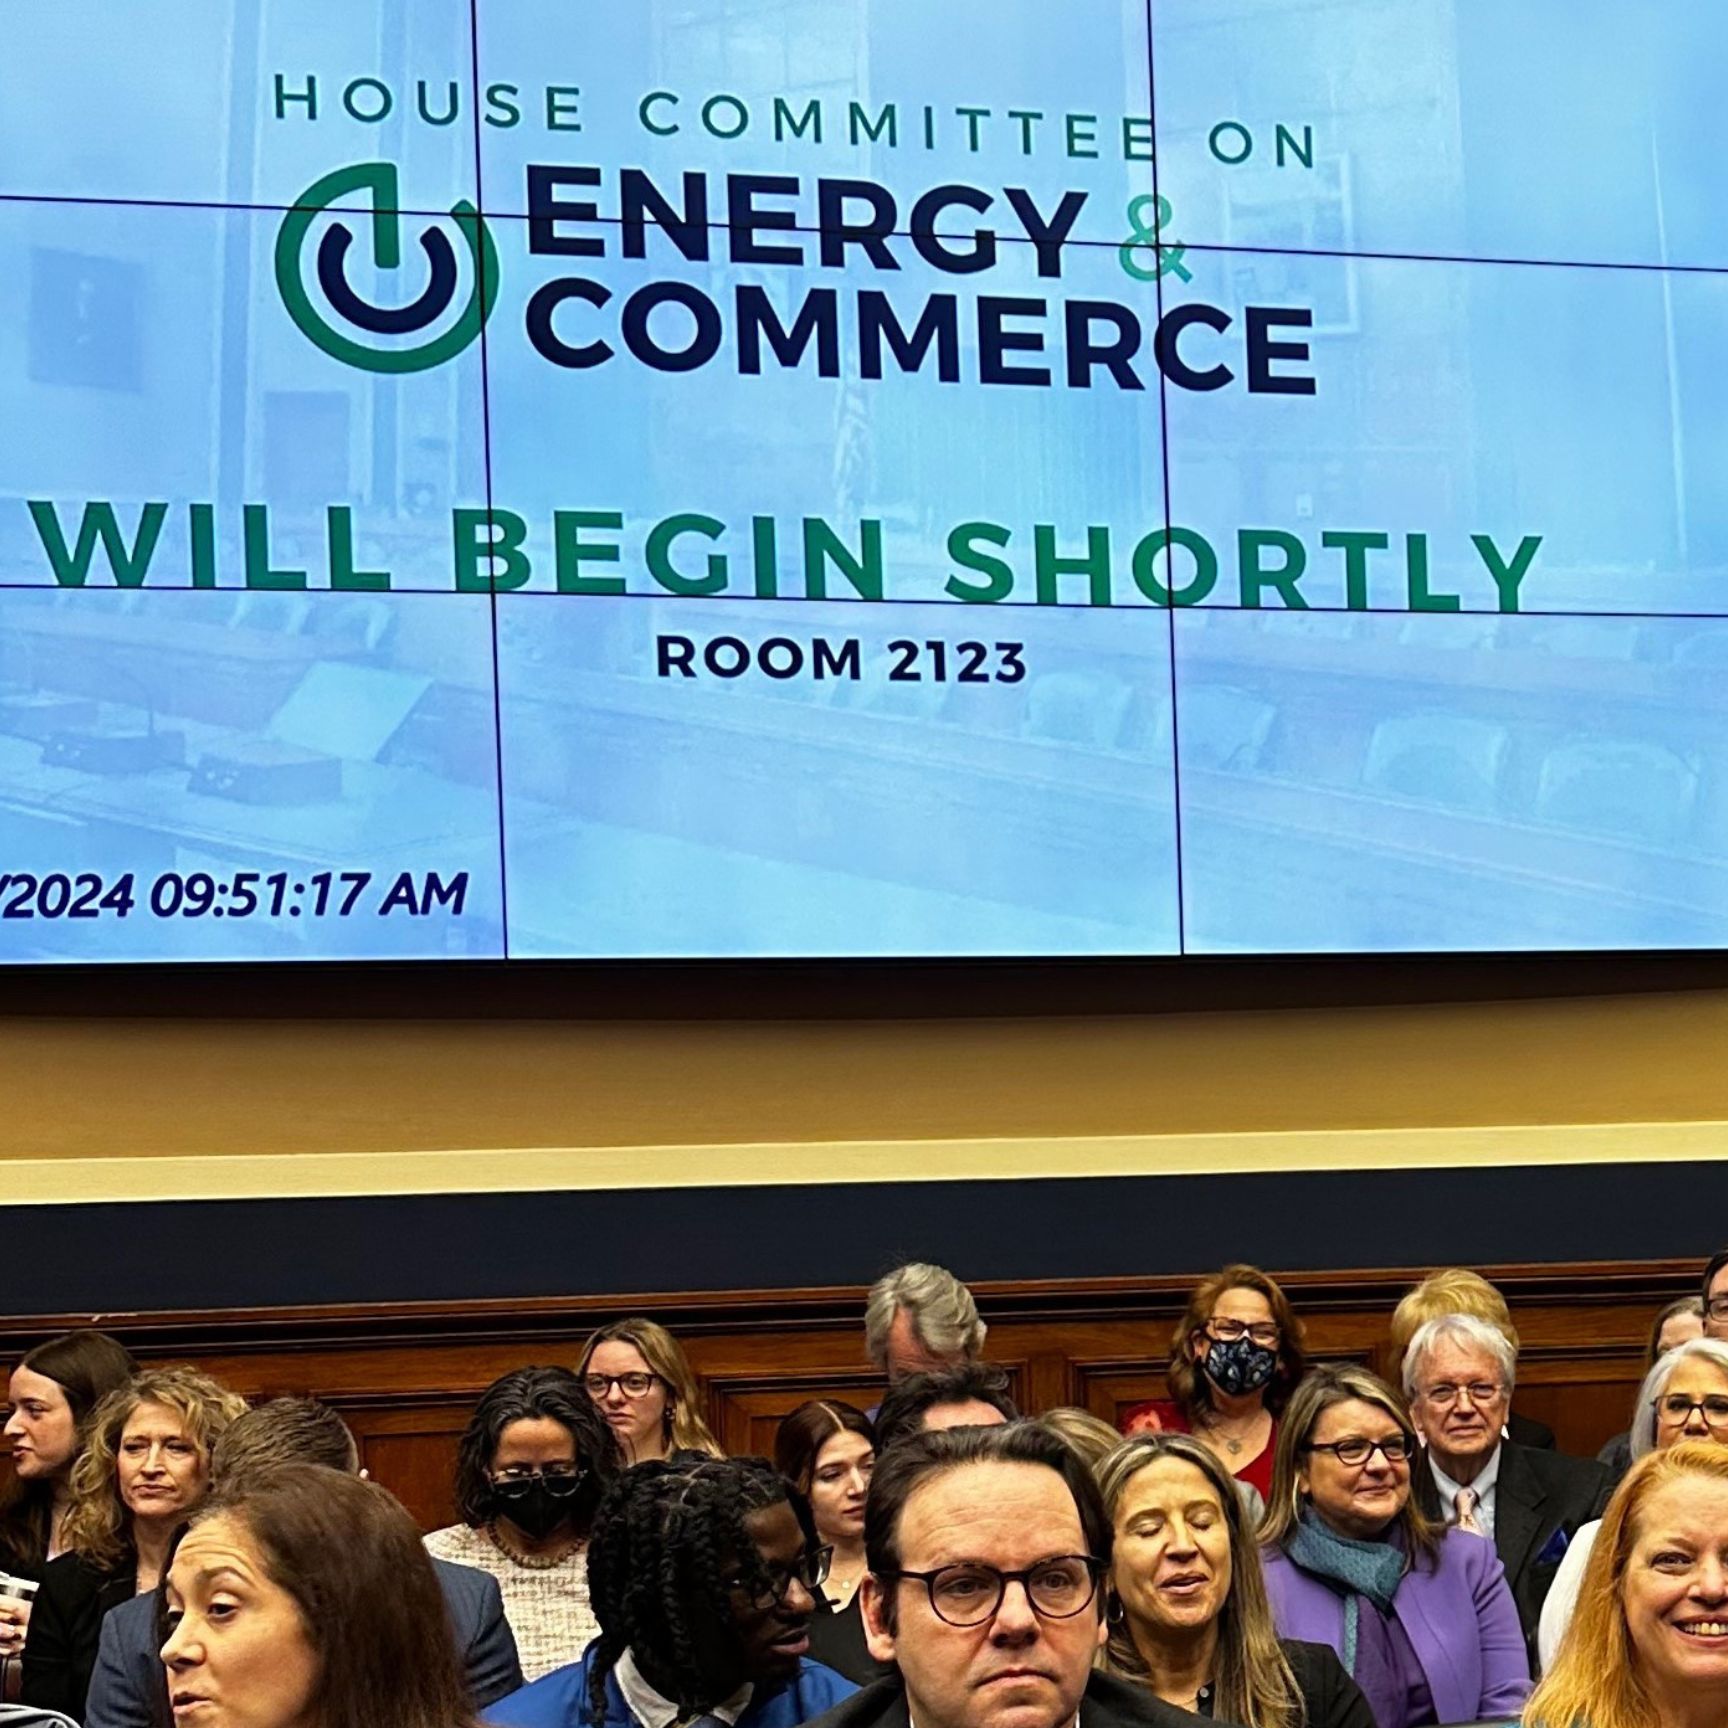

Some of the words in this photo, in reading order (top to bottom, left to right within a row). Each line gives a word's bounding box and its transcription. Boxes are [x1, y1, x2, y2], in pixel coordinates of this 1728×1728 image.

[274, 73, 582, 131] HOUSE
[638, 91, 1155, 162] COMMITTEE
[1208, 120, 1314, 168] ON
[526, 163, 1089, 278] ENERGY
[1118, 194, 1193, 286] &
[525, 276, 1317, 395] COMMERCE
[27, 500, 391, 591] WILL
[452, 507, 883, 600] BEGIN
[943, 521, 1543, 613] SHORTLY
[656, 634, 862, 681] ROOM
[888, 639, 1027, 684] 2123
[150, 871, 372, 918] 09:51:17
[378, 871, 469, 917] AM
